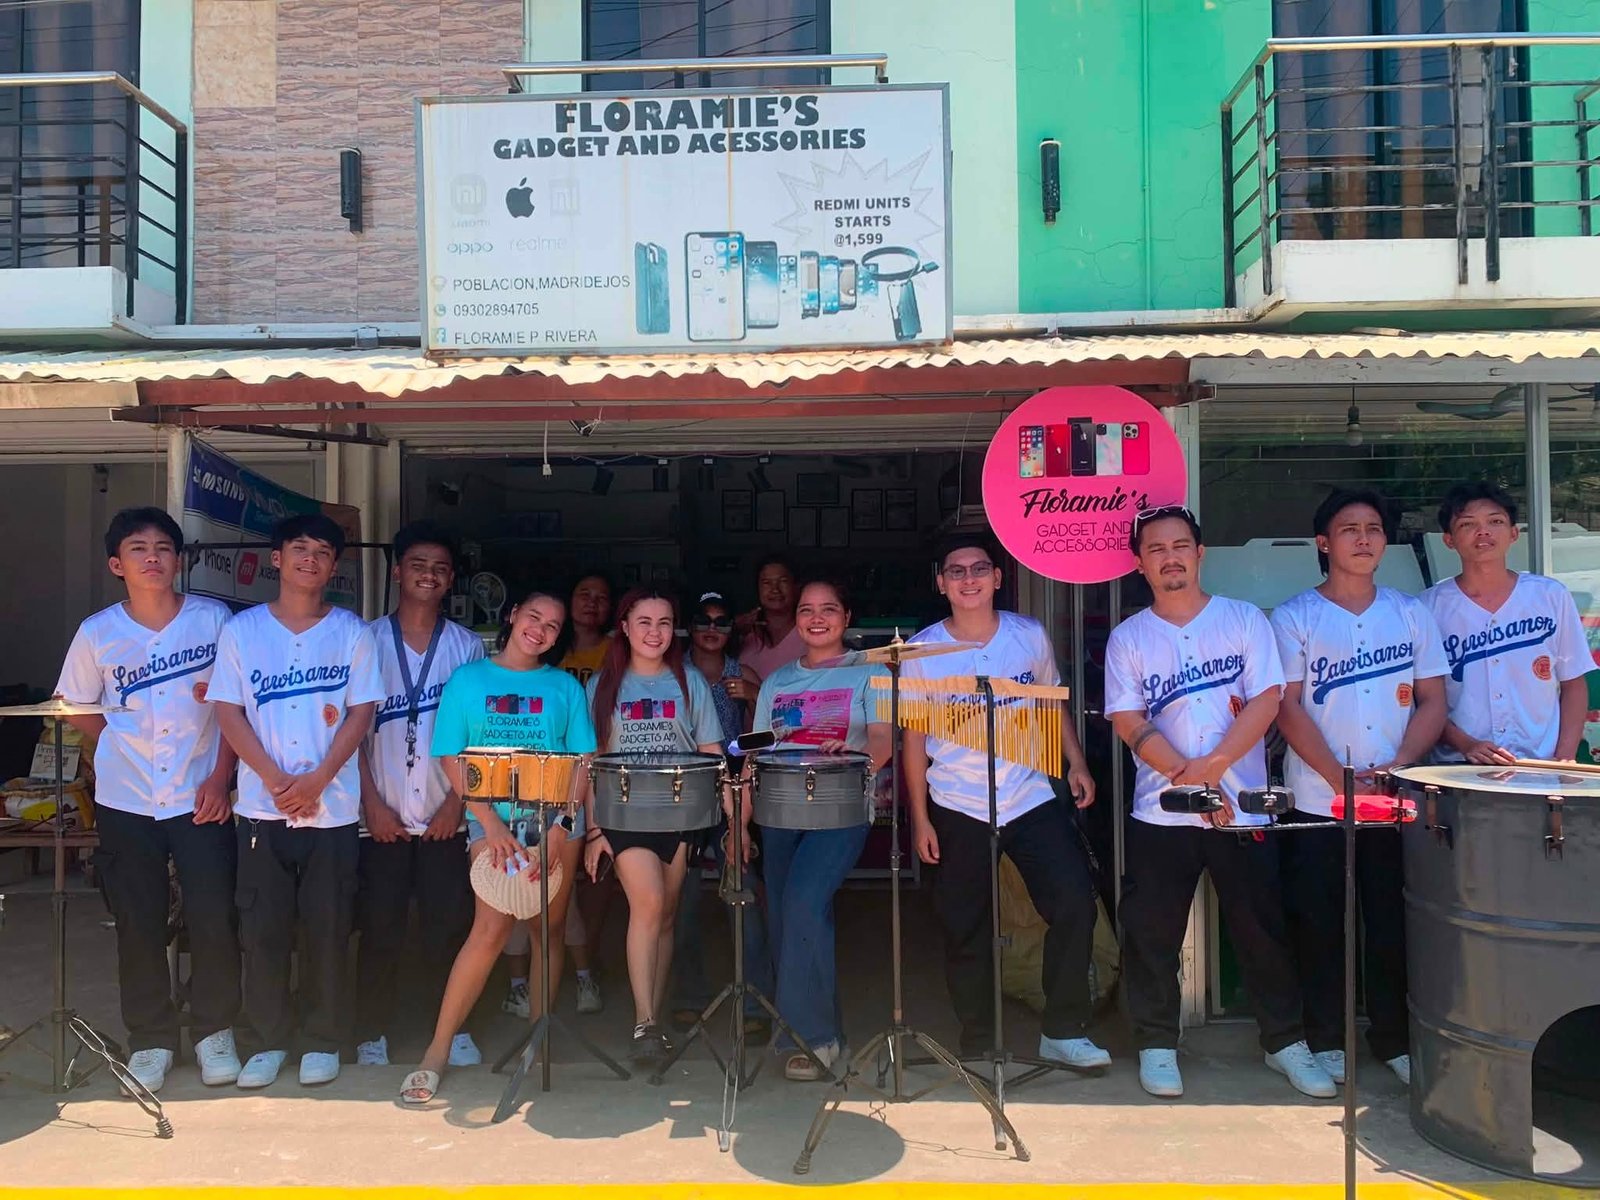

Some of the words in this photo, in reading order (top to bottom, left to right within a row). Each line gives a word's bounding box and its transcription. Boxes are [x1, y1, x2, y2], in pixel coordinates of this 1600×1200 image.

[555, 95, 819, 133] FLORAMIE'S
[493, 136, 609, 160] GADGET
[616, 133, 681, 156] AND
[687, 128, 866, 154] ACESSORIES
[814, 198, 860, 211] REDMI
[866, 196, 911, 209] UNITS
[835, 215, 891, 228] STARTS
[834, 232, 883, 248] @1,599
[447, 241, 494, 256] oppo
[453, 302, 539, 317] 09302894705
[455, 331, 525, 345] FLORAMIE
[545, 329, 598, 343] RIVERA
[1020, 486, 1150, 519] Floramie's
[1036, 522, 1098, 538] GADGET
[1102, 520, 1133, 535] AND
[527, 729, 546, 739] AND
